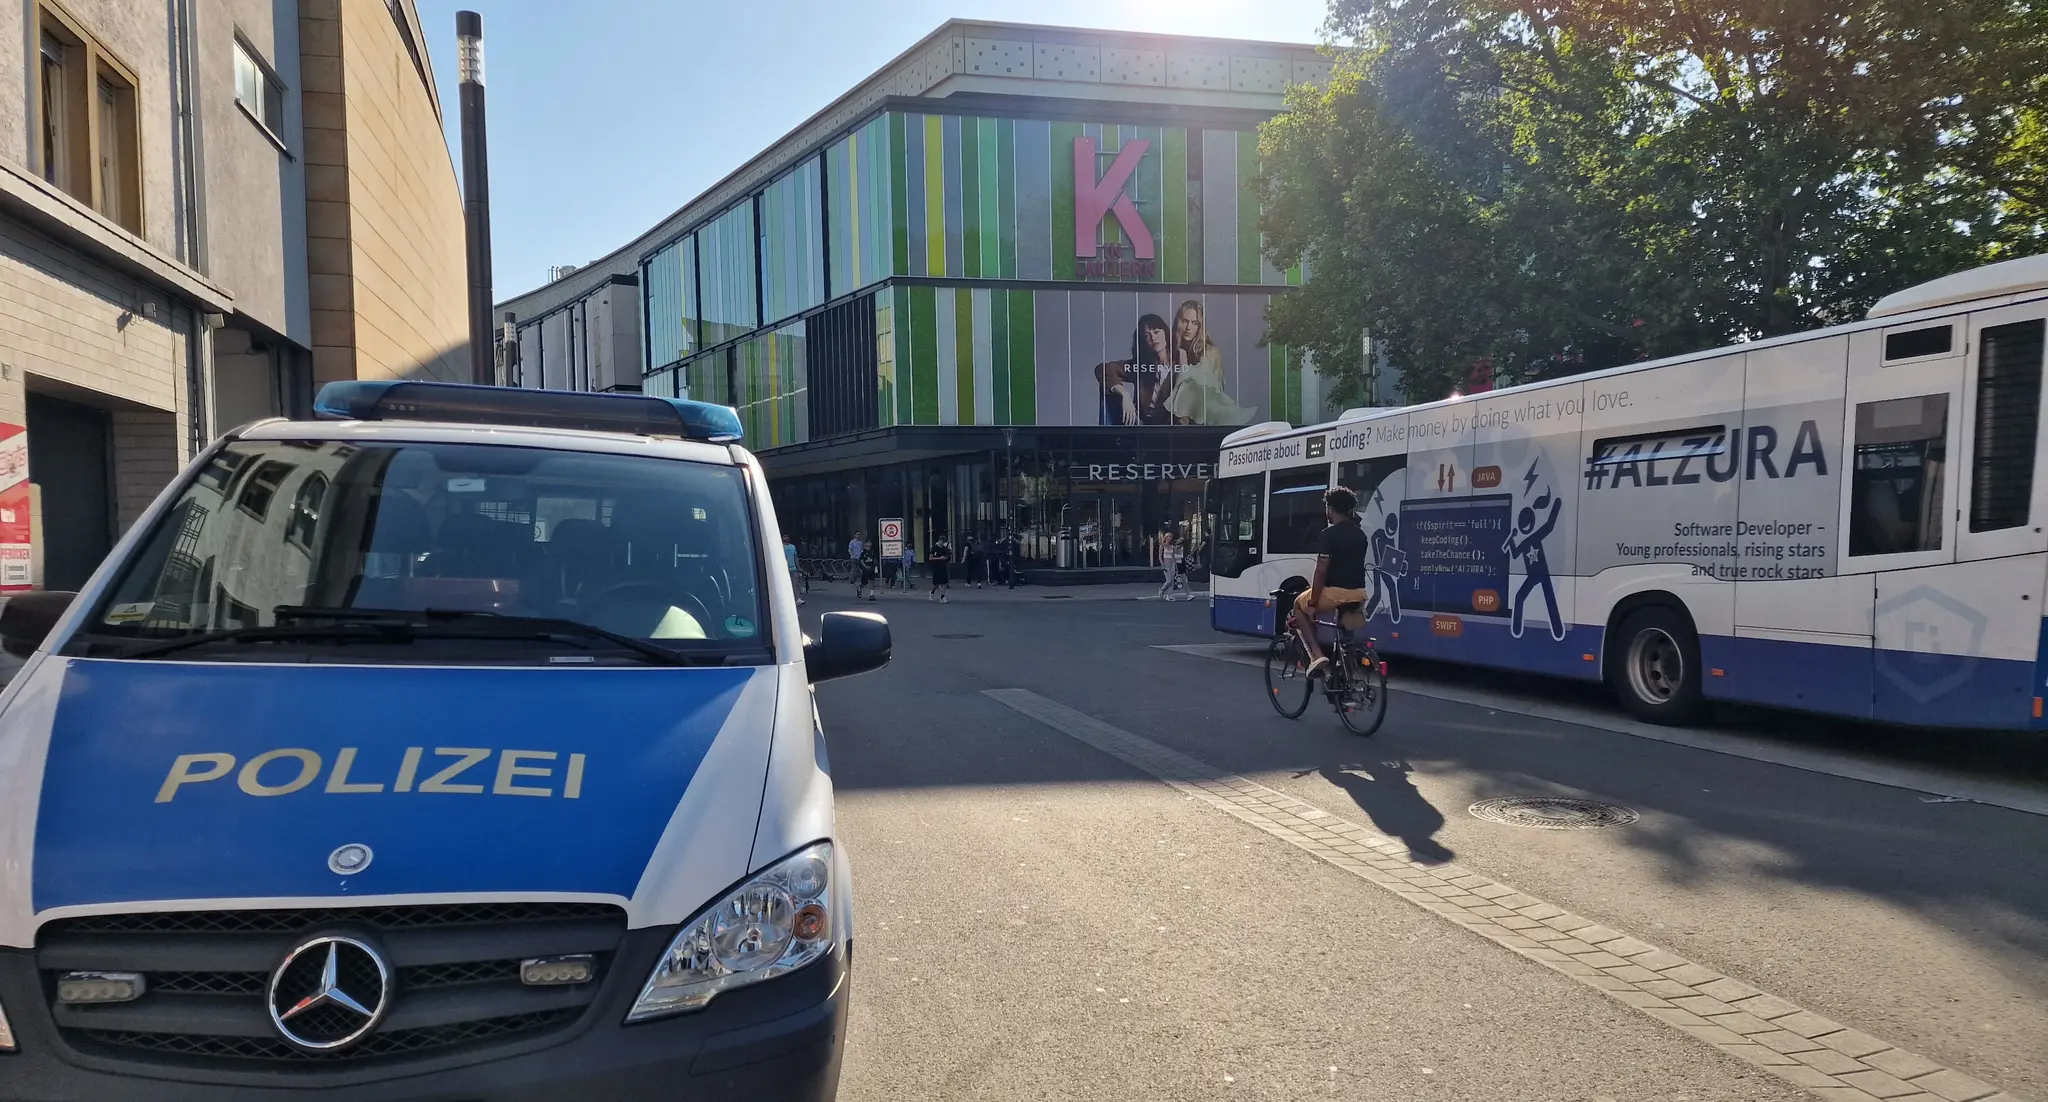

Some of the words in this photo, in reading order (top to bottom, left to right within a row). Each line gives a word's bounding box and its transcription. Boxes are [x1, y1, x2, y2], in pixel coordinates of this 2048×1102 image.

[1073, 137, 1155, 259] K
[1124, 363, 1189, 373] RESERVED
[1228, 447, 1272, 467] Passionate
[1274, 440, 1301, 459] about
[1329, 427, 1372, 451] coding?
[1376, 424, 1405, 443] Make
[1408, 419, 1449, 439] money
[1452, 414, 1468, 433] by
[1472, 408, 1509, 430] doing
[1514, 402, 1551, 425] what
[1556, 397, 1584, 417] you
[1593, 389, 1634, 412] love.
[1584, 420, 1829, 490] #ALZURA
[1476, 473, 1496, 483] JAVA
[1674, 522, 1732, 537] Software
[1736, 520, 1813, 538] Developer
[1616, 542, 1651, 558] Young
[1654, 542, 1740, 559] professionals,
[1744, 542, 1784, 560] rising
[1788, 543, 1825, 557] stars
[1691, 562, 1715, 577] and
[1719, 564, 1748, 578] true
[1751, 563, 1783, 579] rock
[1787, 566, 1824, 579] stars
[1478, 595, 1494, 605] PHP
[1435, 620, 1457, 631] SWIFT
[153, 747, 586, 803] POLIZEI
